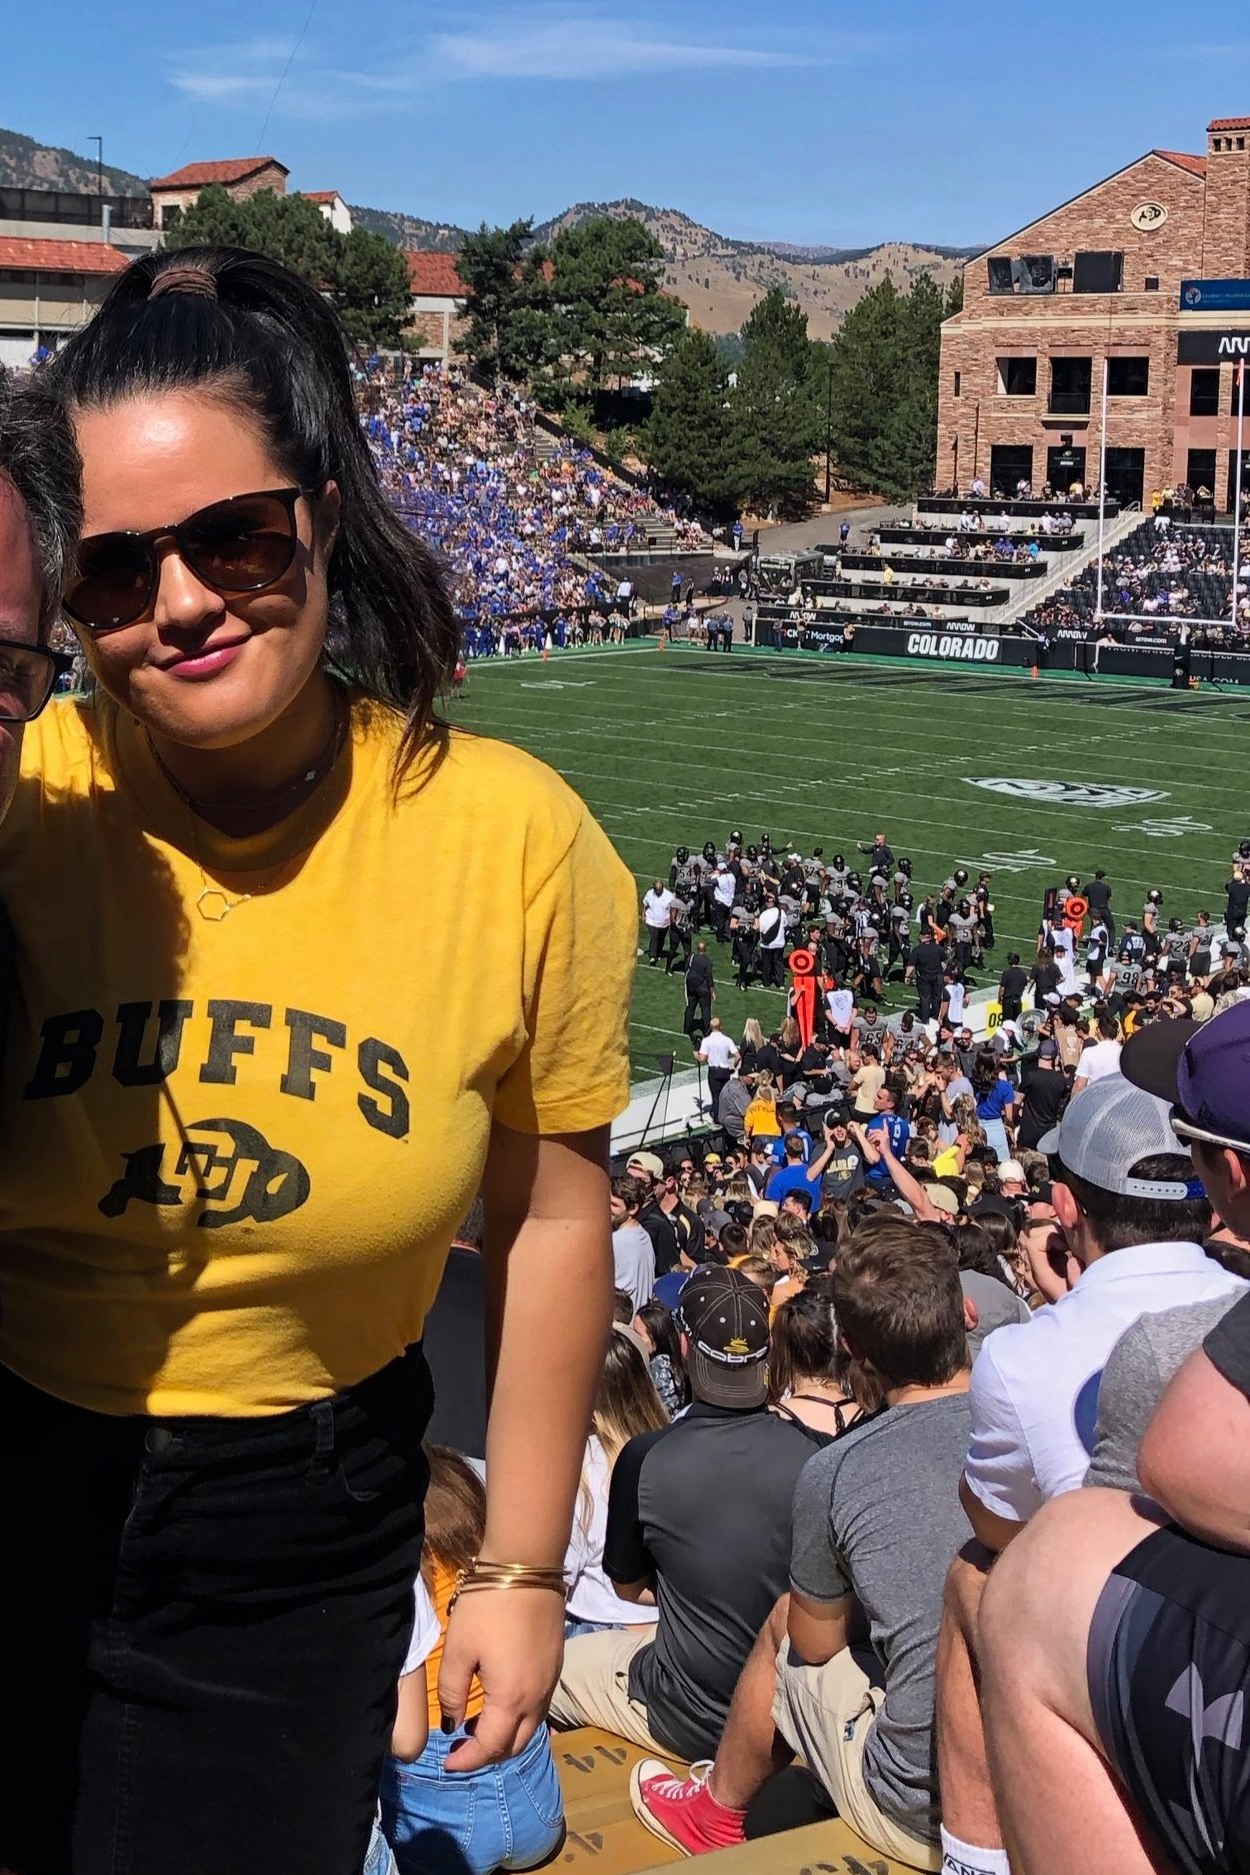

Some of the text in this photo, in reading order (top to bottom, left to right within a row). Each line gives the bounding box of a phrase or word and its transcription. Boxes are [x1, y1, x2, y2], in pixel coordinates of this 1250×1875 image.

[907, 633, 1000, 660] COLORADO
[866, 1032, 882, 1045] 65
[22, 998, 411, 1140] BUFFS
[697, 1339, 769, 1364] cobra
